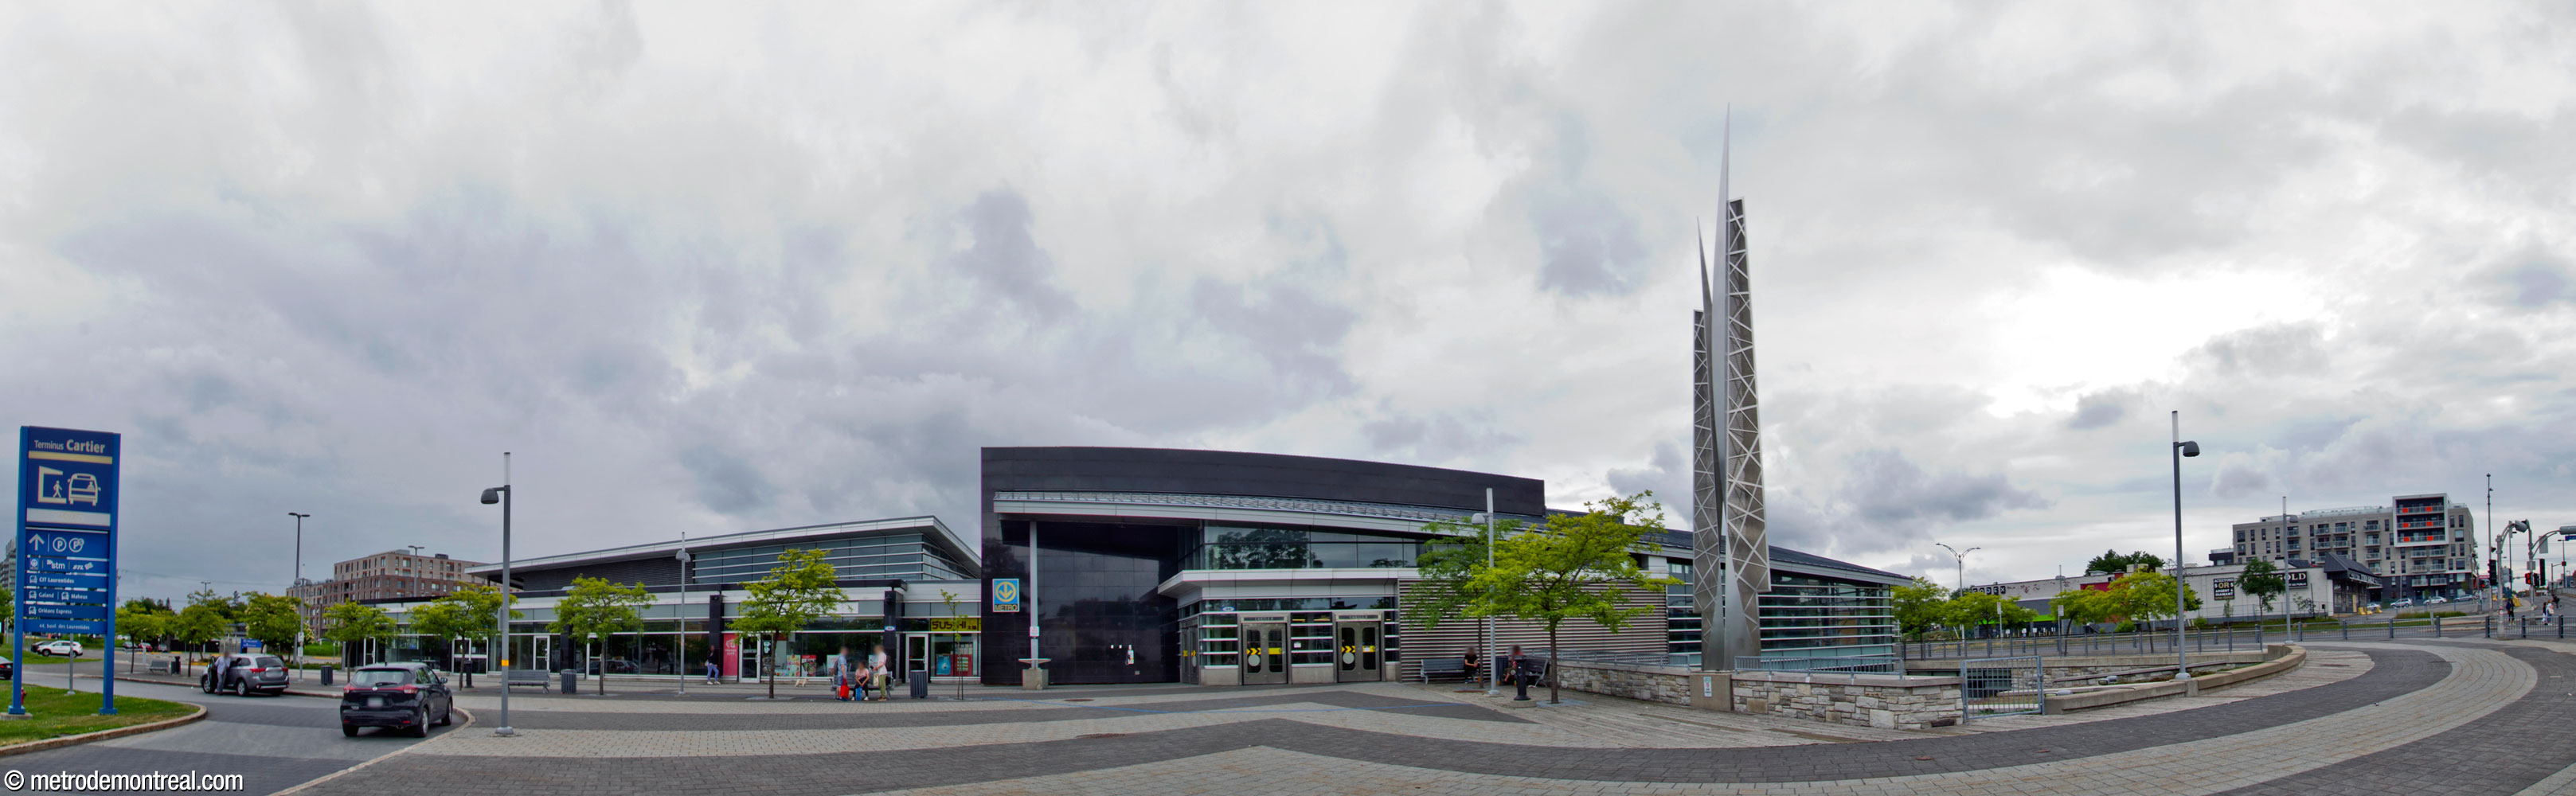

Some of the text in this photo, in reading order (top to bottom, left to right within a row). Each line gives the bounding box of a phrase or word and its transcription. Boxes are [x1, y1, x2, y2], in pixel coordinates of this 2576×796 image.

[34, 439, 105, 453] Terminus Cartier
[932, 621, 966, 630] SUSHI
